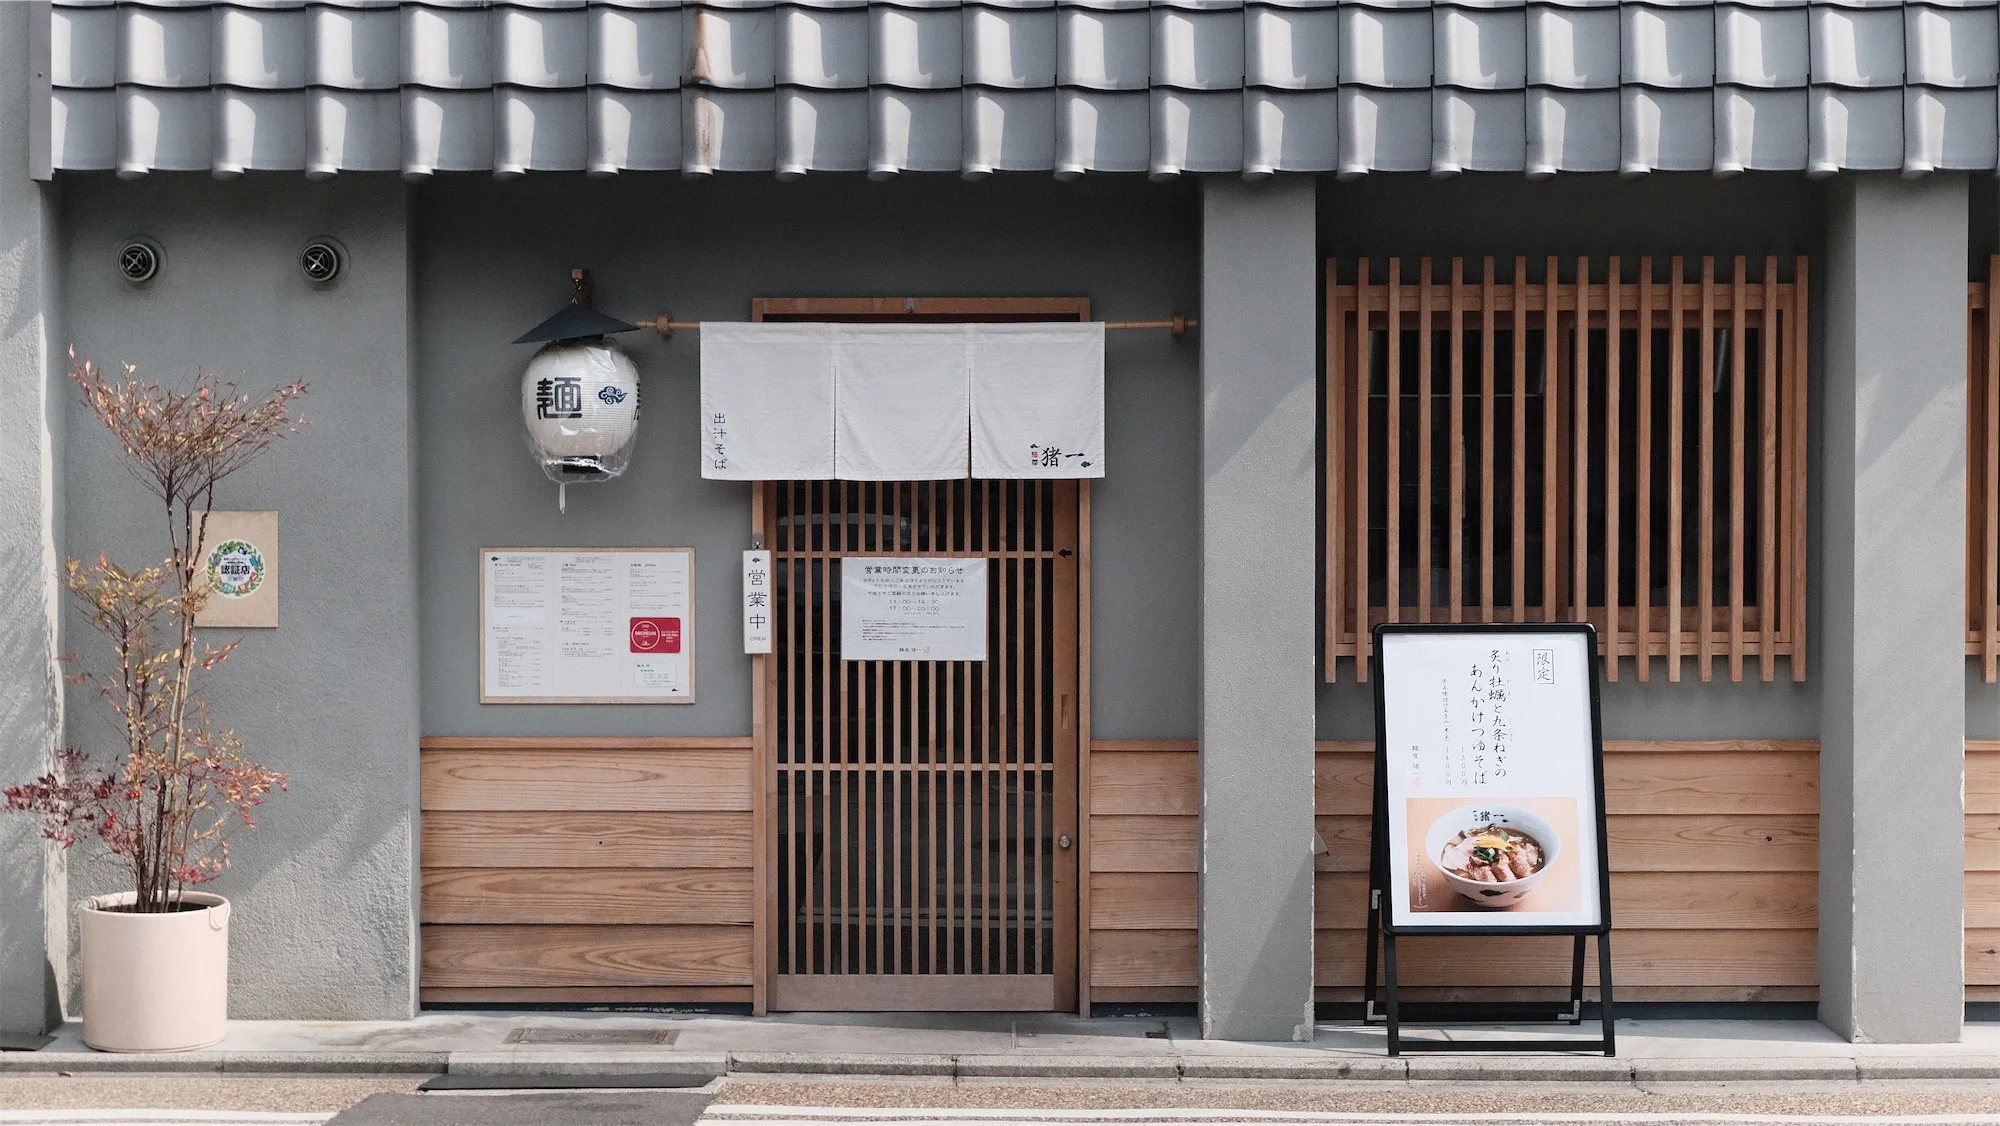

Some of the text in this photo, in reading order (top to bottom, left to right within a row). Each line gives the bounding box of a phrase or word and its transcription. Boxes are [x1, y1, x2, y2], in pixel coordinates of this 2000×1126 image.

[712, 412, 727, 470] 出汁そば
[1041, 447, 1085, 467] 猪一
[865, 566, 964, 575] 営業時間変更のお知らせ
[748, 569, 766, 630] 営業中
[1537, 652, 1551, 681] 限定
[1470, 664, 1488, 785] あんかけつゆそば
